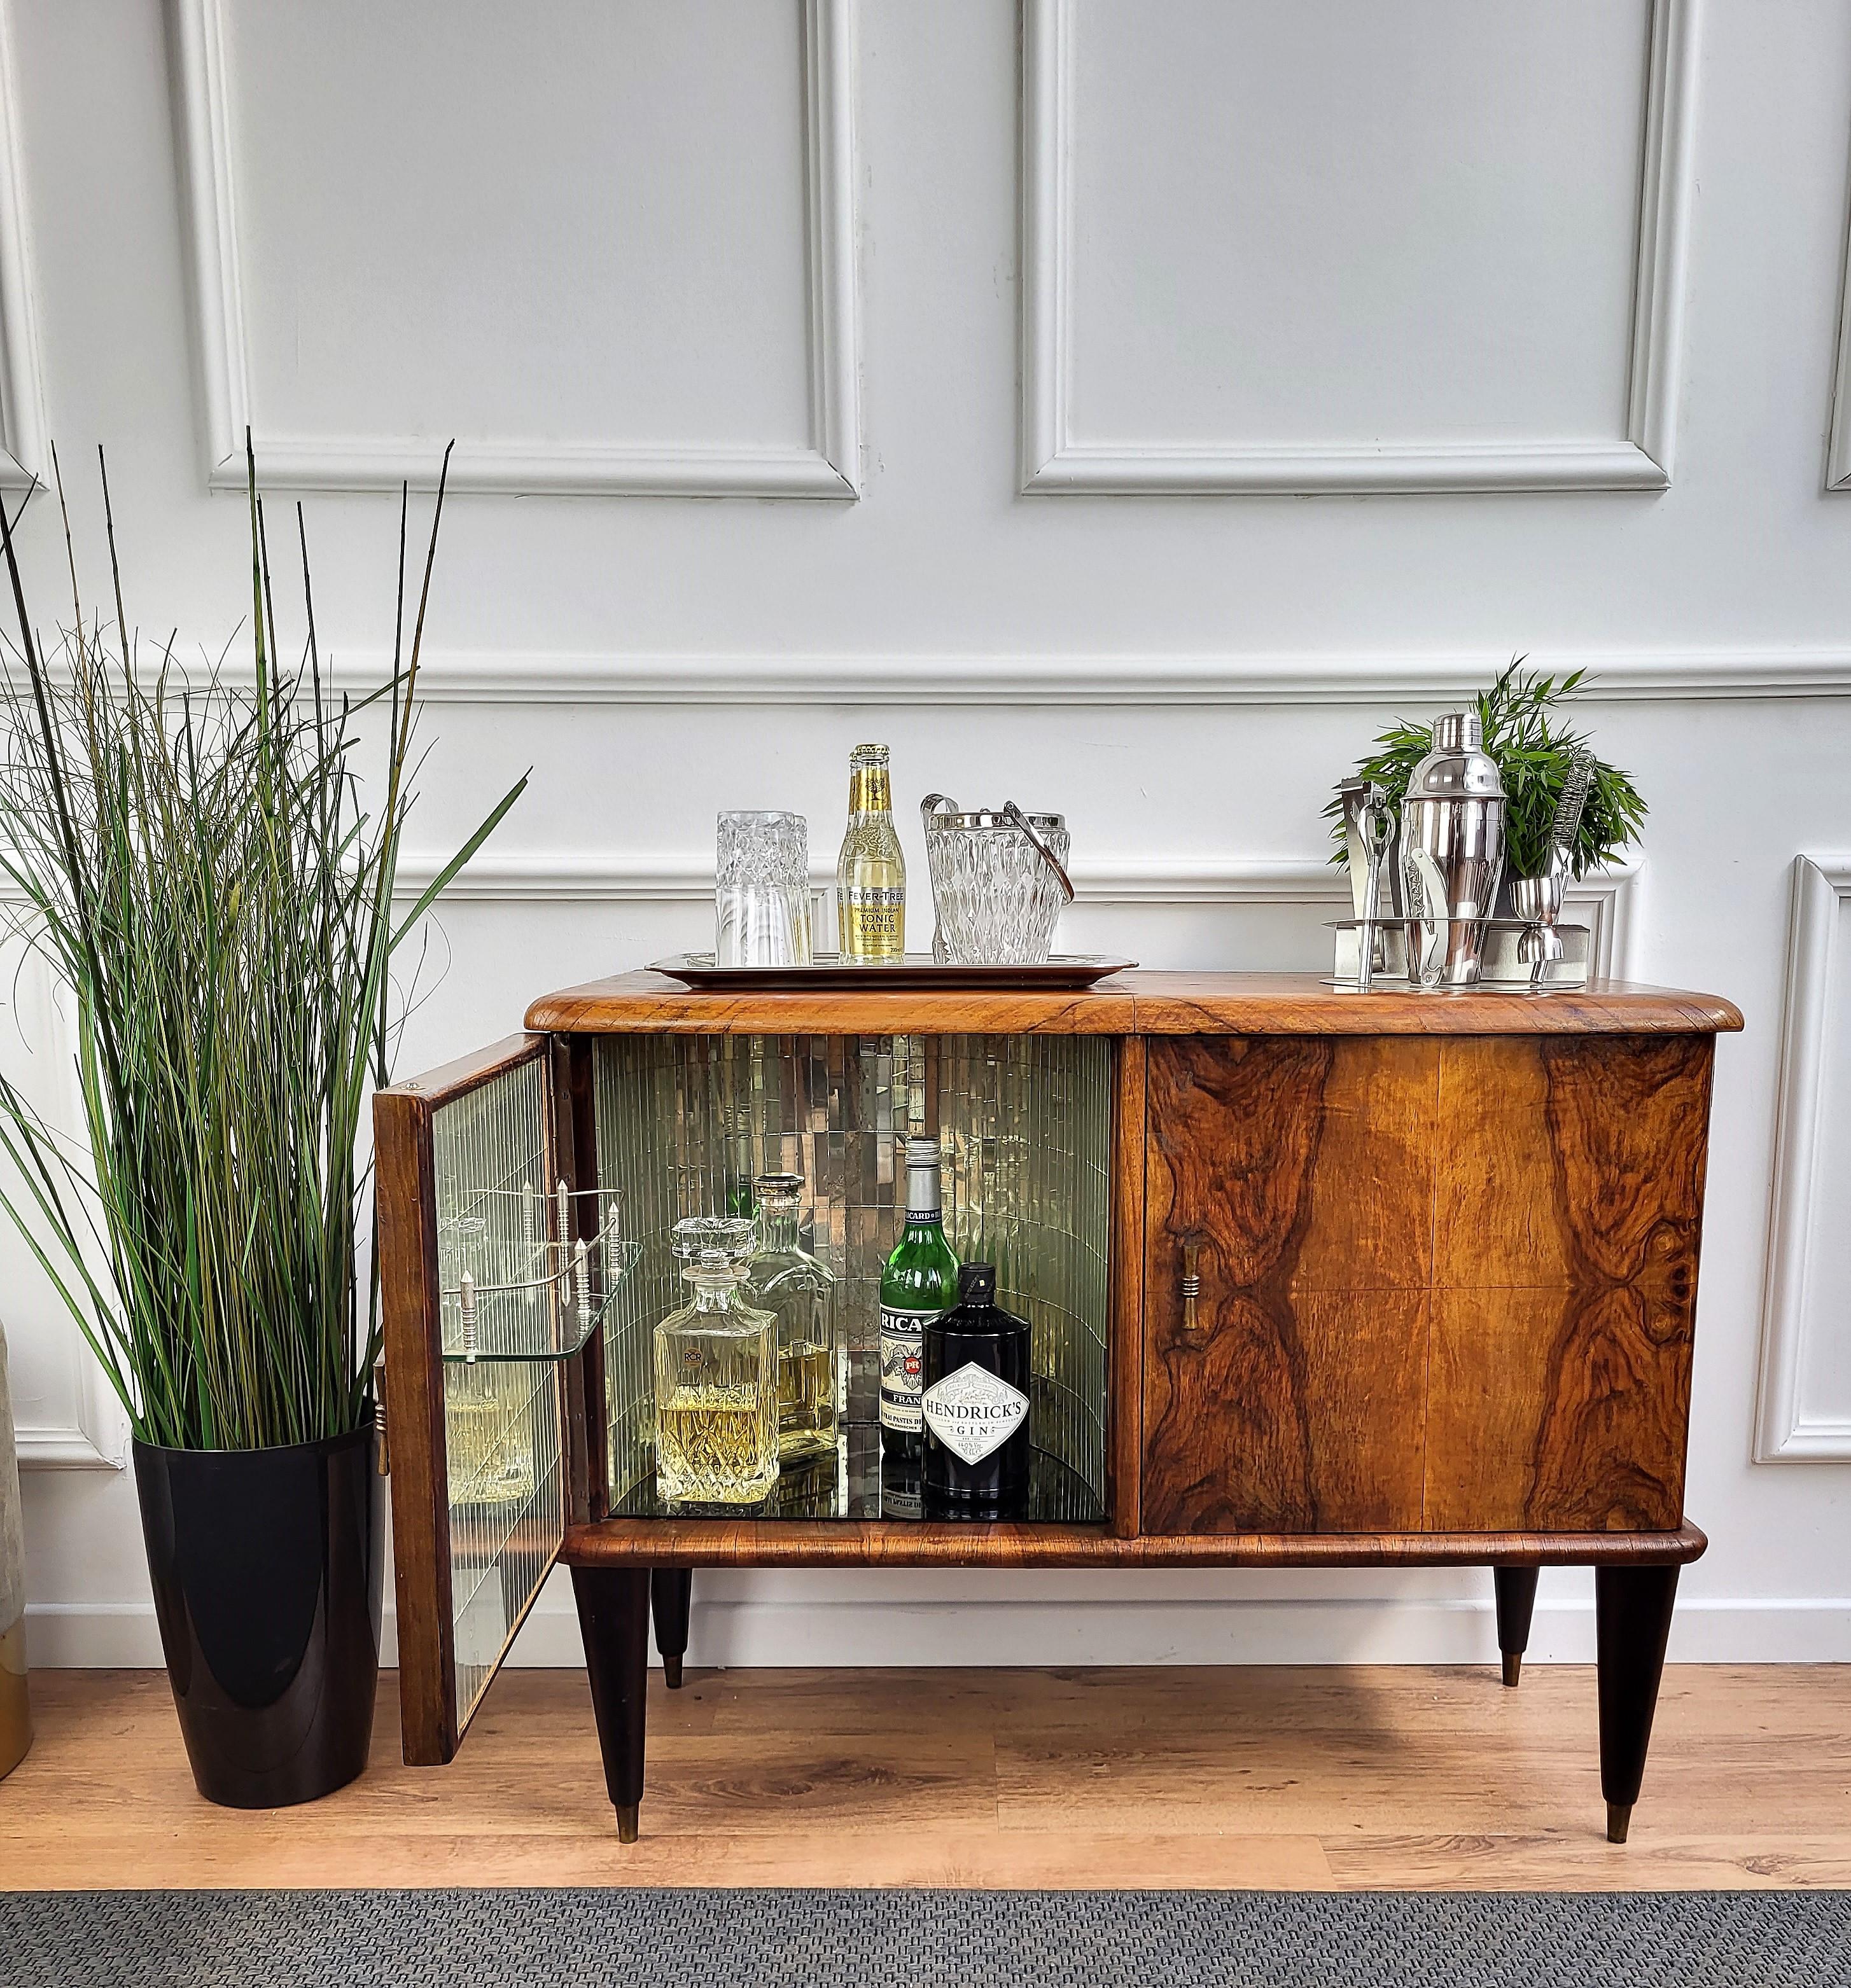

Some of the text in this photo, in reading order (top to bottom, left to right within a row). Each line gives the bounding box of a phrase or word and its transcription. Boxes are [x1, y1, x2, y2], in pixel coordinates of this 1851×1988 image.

[849, 891, 904, 900] FEVER-TREE
[860, 914, 895, 923] TONIC
[860, 924, 896, 933] WATER
[905, 1361, 919, 1370] PR
[893, 1394, 921, 1405] FRAN
[926, 1399, 1021, 1419] HENDRICK'S
[893, 1415, 913, 1424] PASTIS
[957, 1426, 988, 1435] GIN
